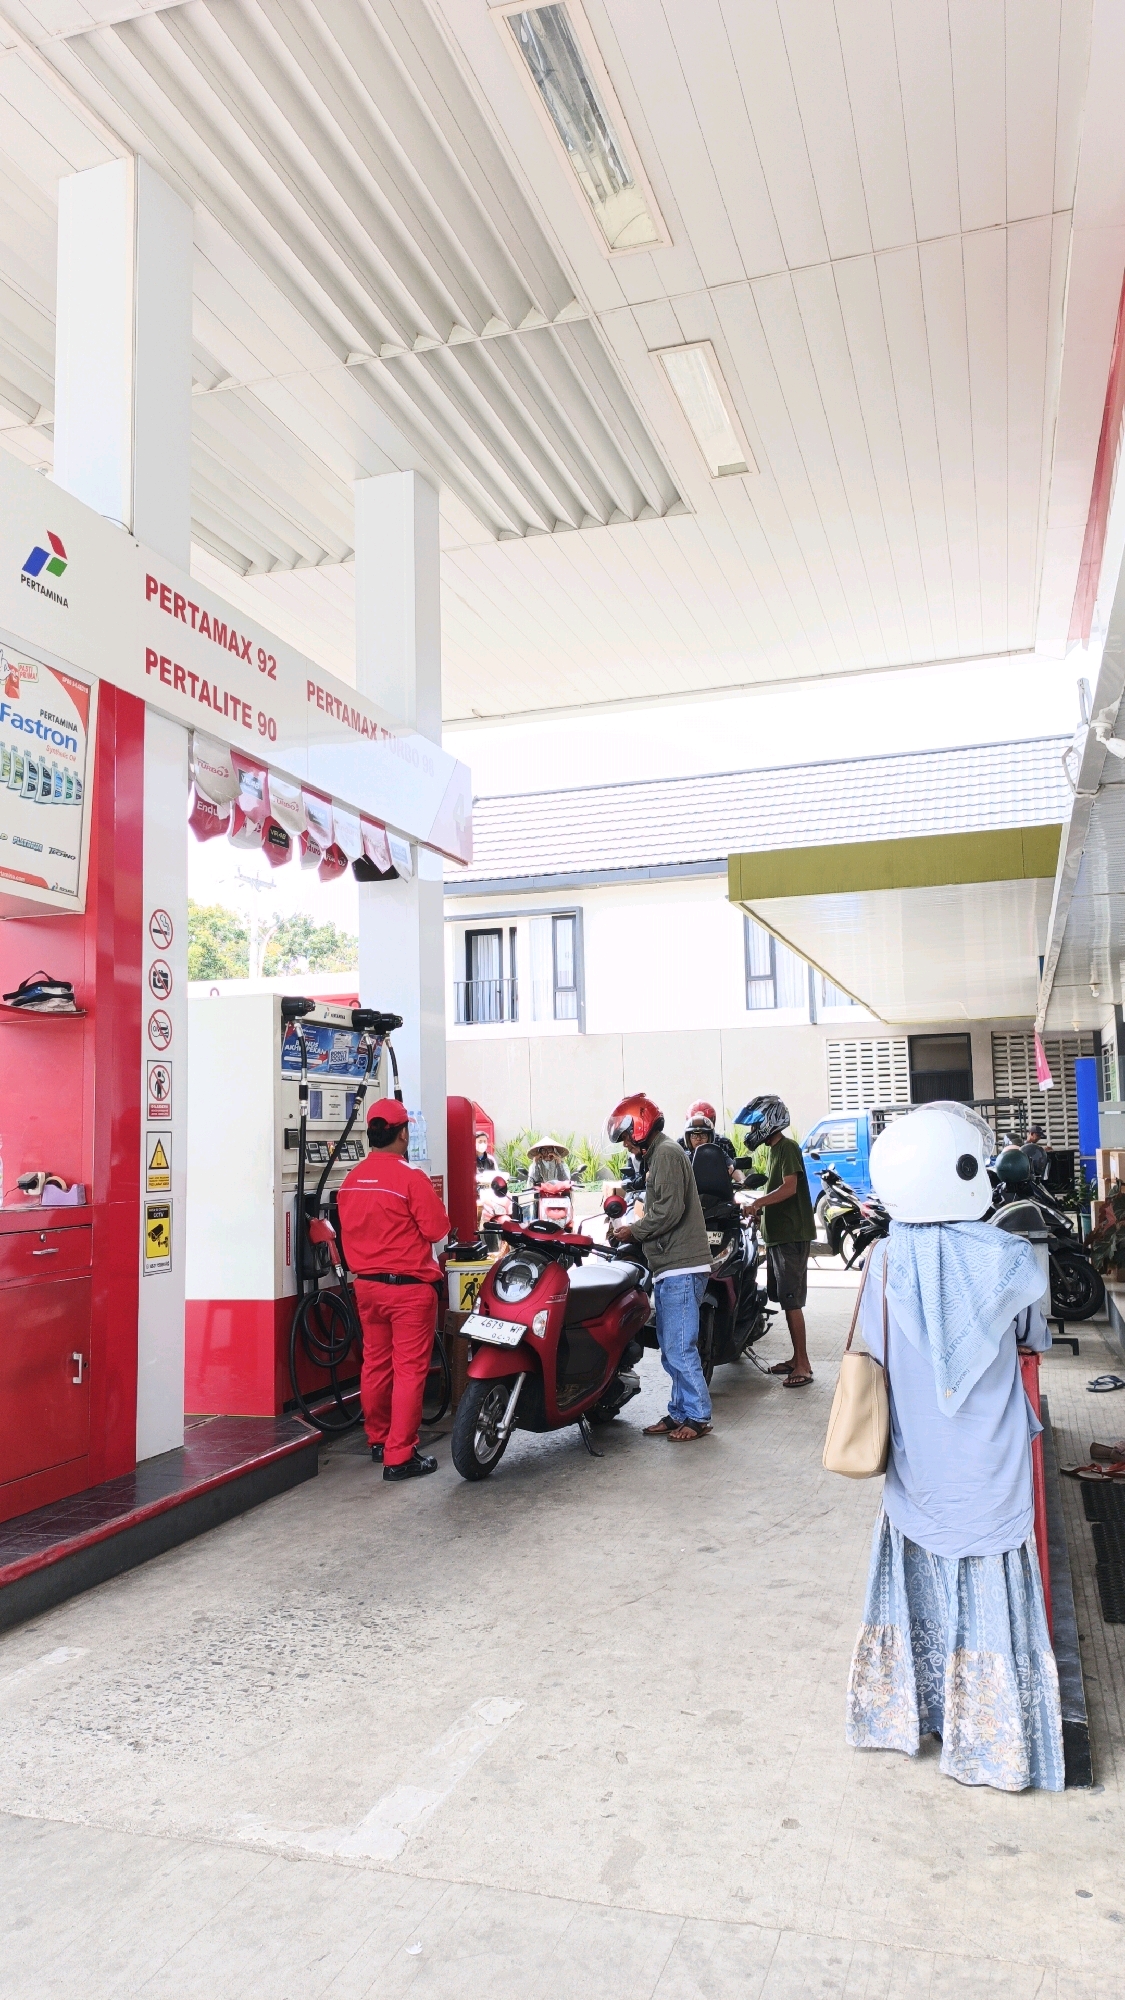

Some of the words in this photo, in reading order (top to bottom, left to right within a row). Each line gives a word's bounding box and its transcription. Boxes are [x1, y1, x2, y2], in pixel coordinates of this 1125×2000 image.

[20, 573, 69, 608] PERTAMINA
[145, 573, 252, 665] PERTAMAX
[257, 648, 277, 680] 92
[145, 647, 252, 729] PERTALITE
[257, 711, 277, 741] 90
[0, 702, 78, 752] Fastron
[40, 708, 78, 732] PERTAMINA
[306, 679, 378, 743] PERTAMAX
[381, 728, 419, 768] TURBO
[422, 754, 434, 777] 98
[46, 744, 68, 760] Synthetic
[198, 761, 223, 777] TURBO
[12, 836, 43, 852] PLATINUM
[48, 847, 76, 860] TECHNO
[993, 1250, 1027, 1299] JOURNEY
[481, 1319, 504, 1330] 4679
